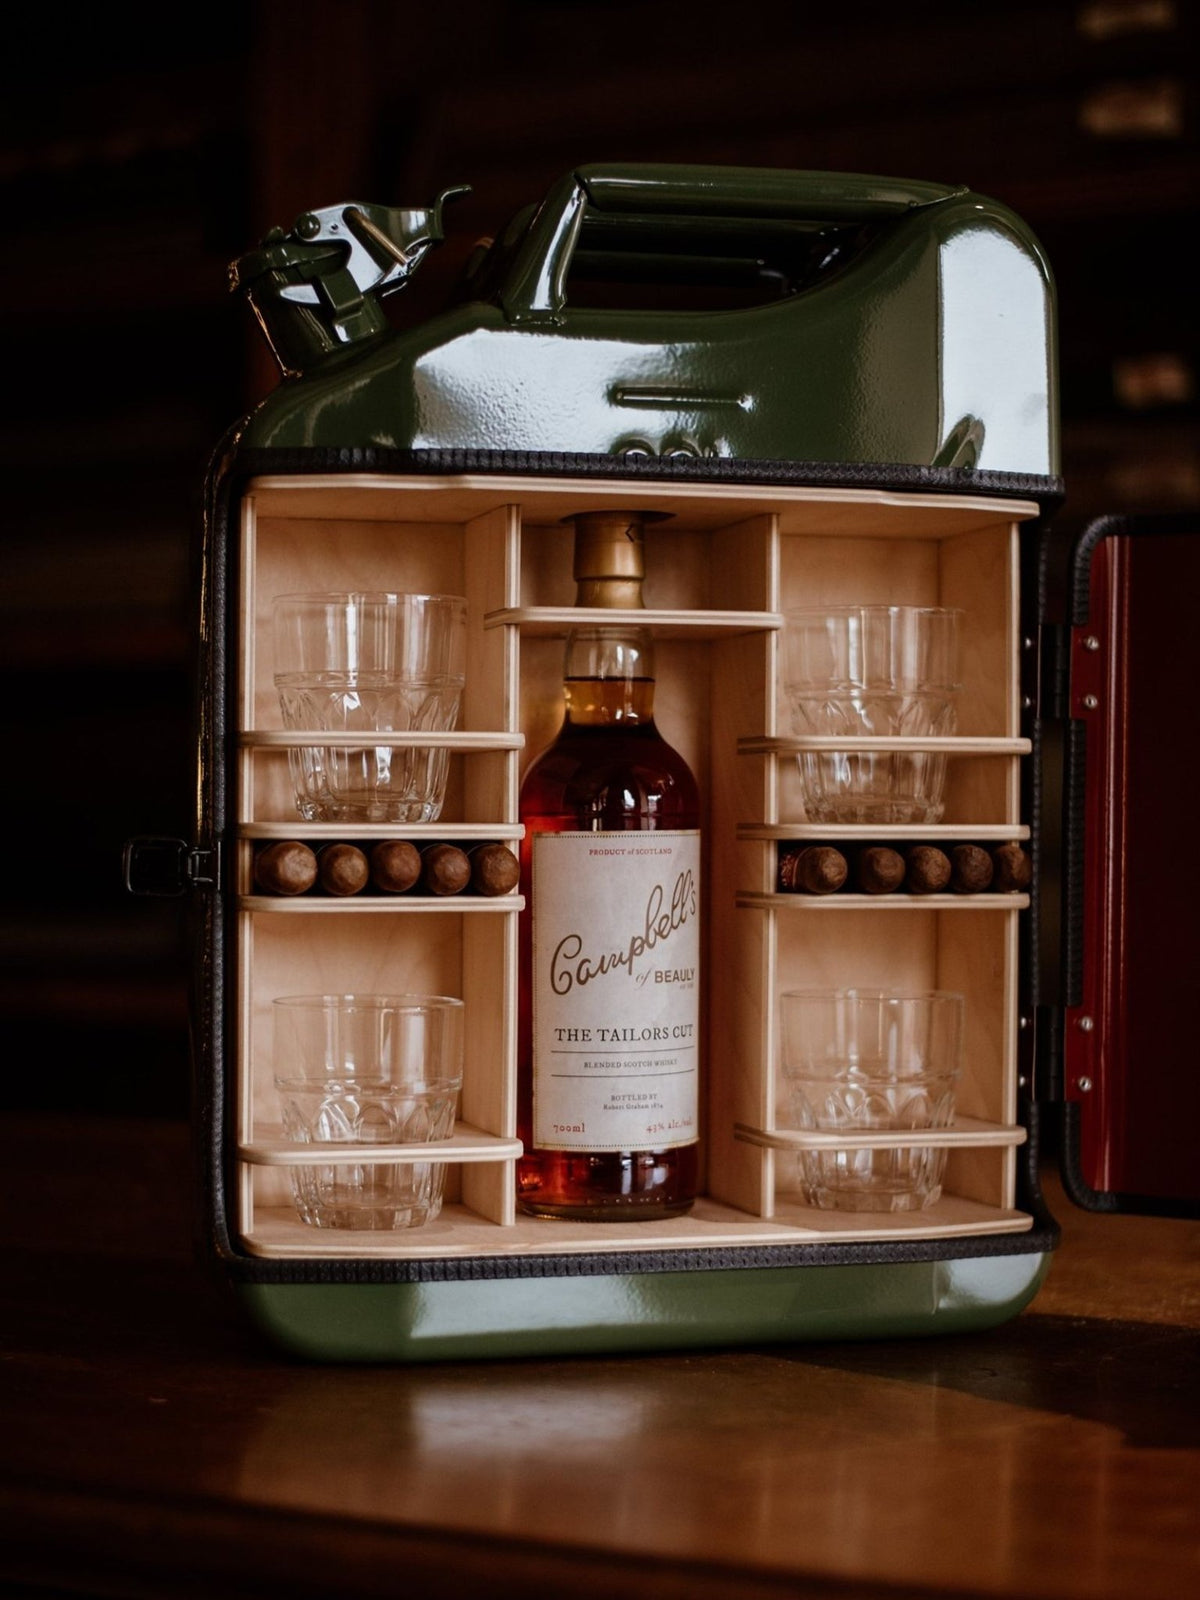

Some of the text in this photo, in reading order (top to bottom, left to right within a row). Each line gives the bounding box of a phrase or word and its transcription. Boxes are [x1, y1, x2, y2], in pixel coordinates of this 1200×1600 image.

[589, 848, 626, 856] PRODUCT
[635, 847, 672, 855] SCOTLAND
[550, 869, 696, 995] Campbell's
[654, 967, 695, 984] BEAULY
[554, 1024, 694, 1042] THE TAILORS CUT
[584, 1061, 622, 1069] BLENDED
[623, 1060, 652, 1068] SCOTCH
[553, 1122, 586, 1133] 700ml
